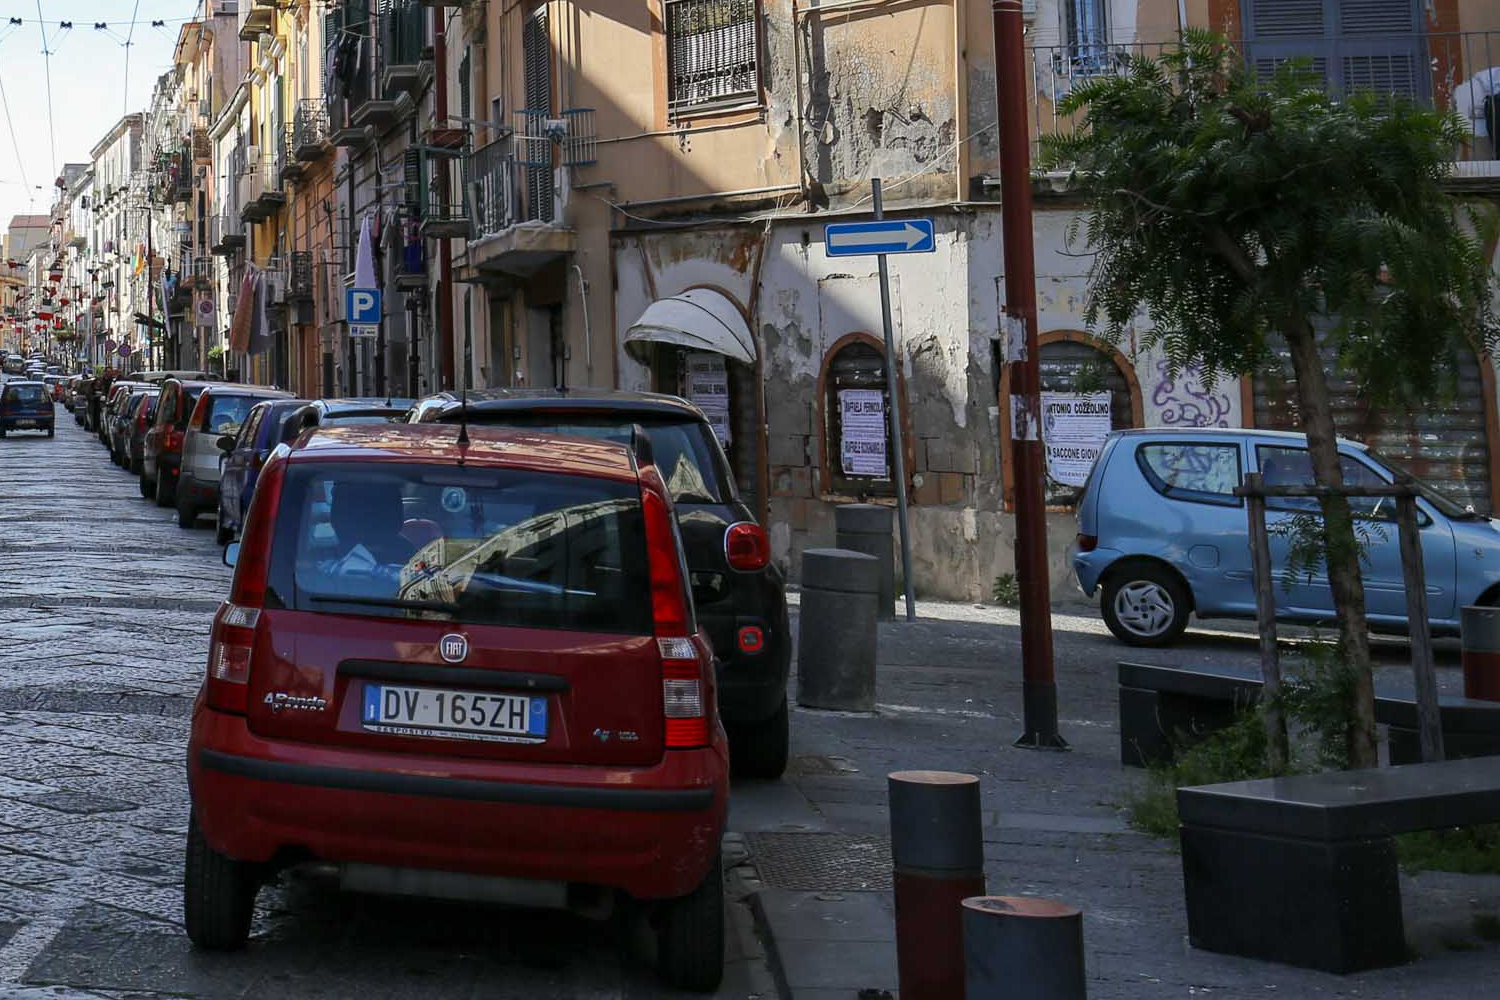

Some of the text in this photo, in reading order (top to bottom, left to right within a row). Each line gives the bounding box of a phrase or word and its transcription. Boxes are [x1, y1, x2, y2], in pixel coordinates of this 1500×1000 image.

[353, 292, 374, 320] P
[1074, 403, 1109, 414] COZZOLINO
[1052, 447, 1080, 459] SACCONE
[446, 641, 463, 656] FIAT
[384, 690, 525, 730] DV 165ZH
